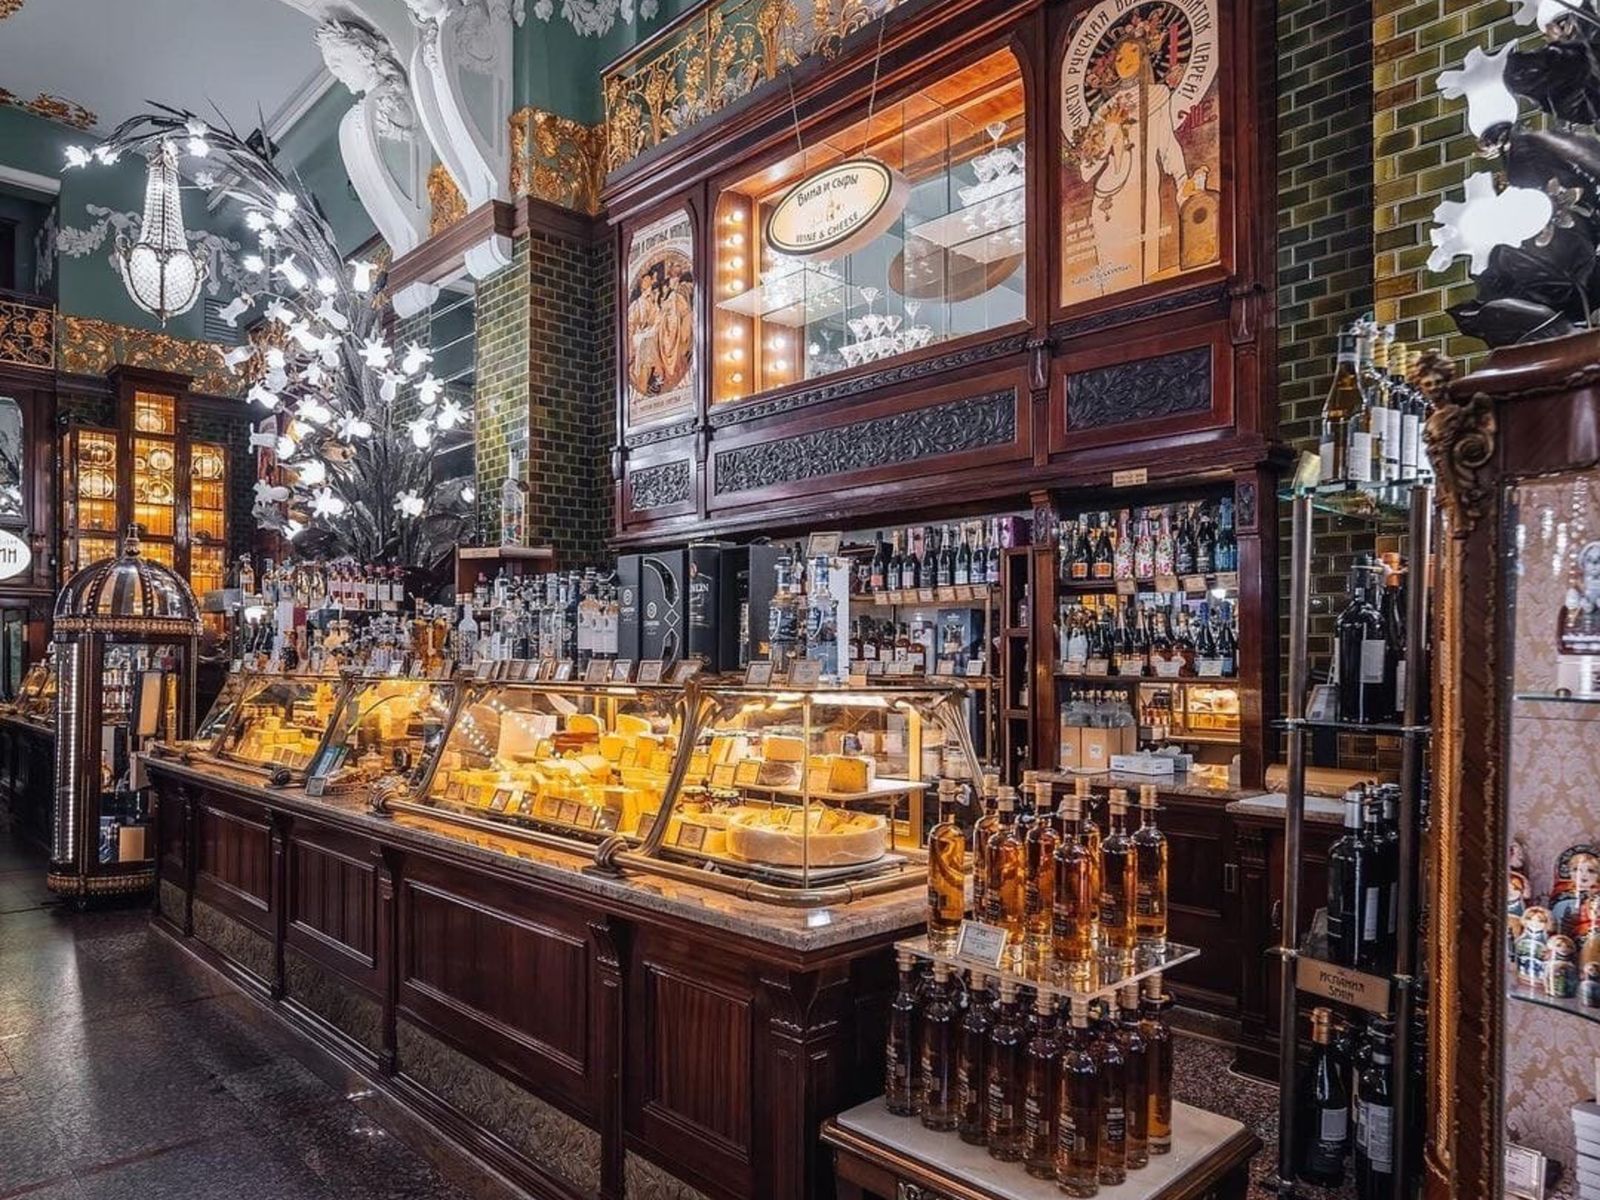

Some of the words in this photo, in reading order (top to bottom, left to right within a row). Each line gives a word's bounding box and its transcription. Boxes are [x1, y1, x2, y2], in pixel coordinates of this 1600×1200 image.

[1178, 0, 1211, 36] ИТОК
[796, 231, 817, 243] WINE
[818, 231, 825, 240] &
[828, 211, 858, 235] CHEESE
